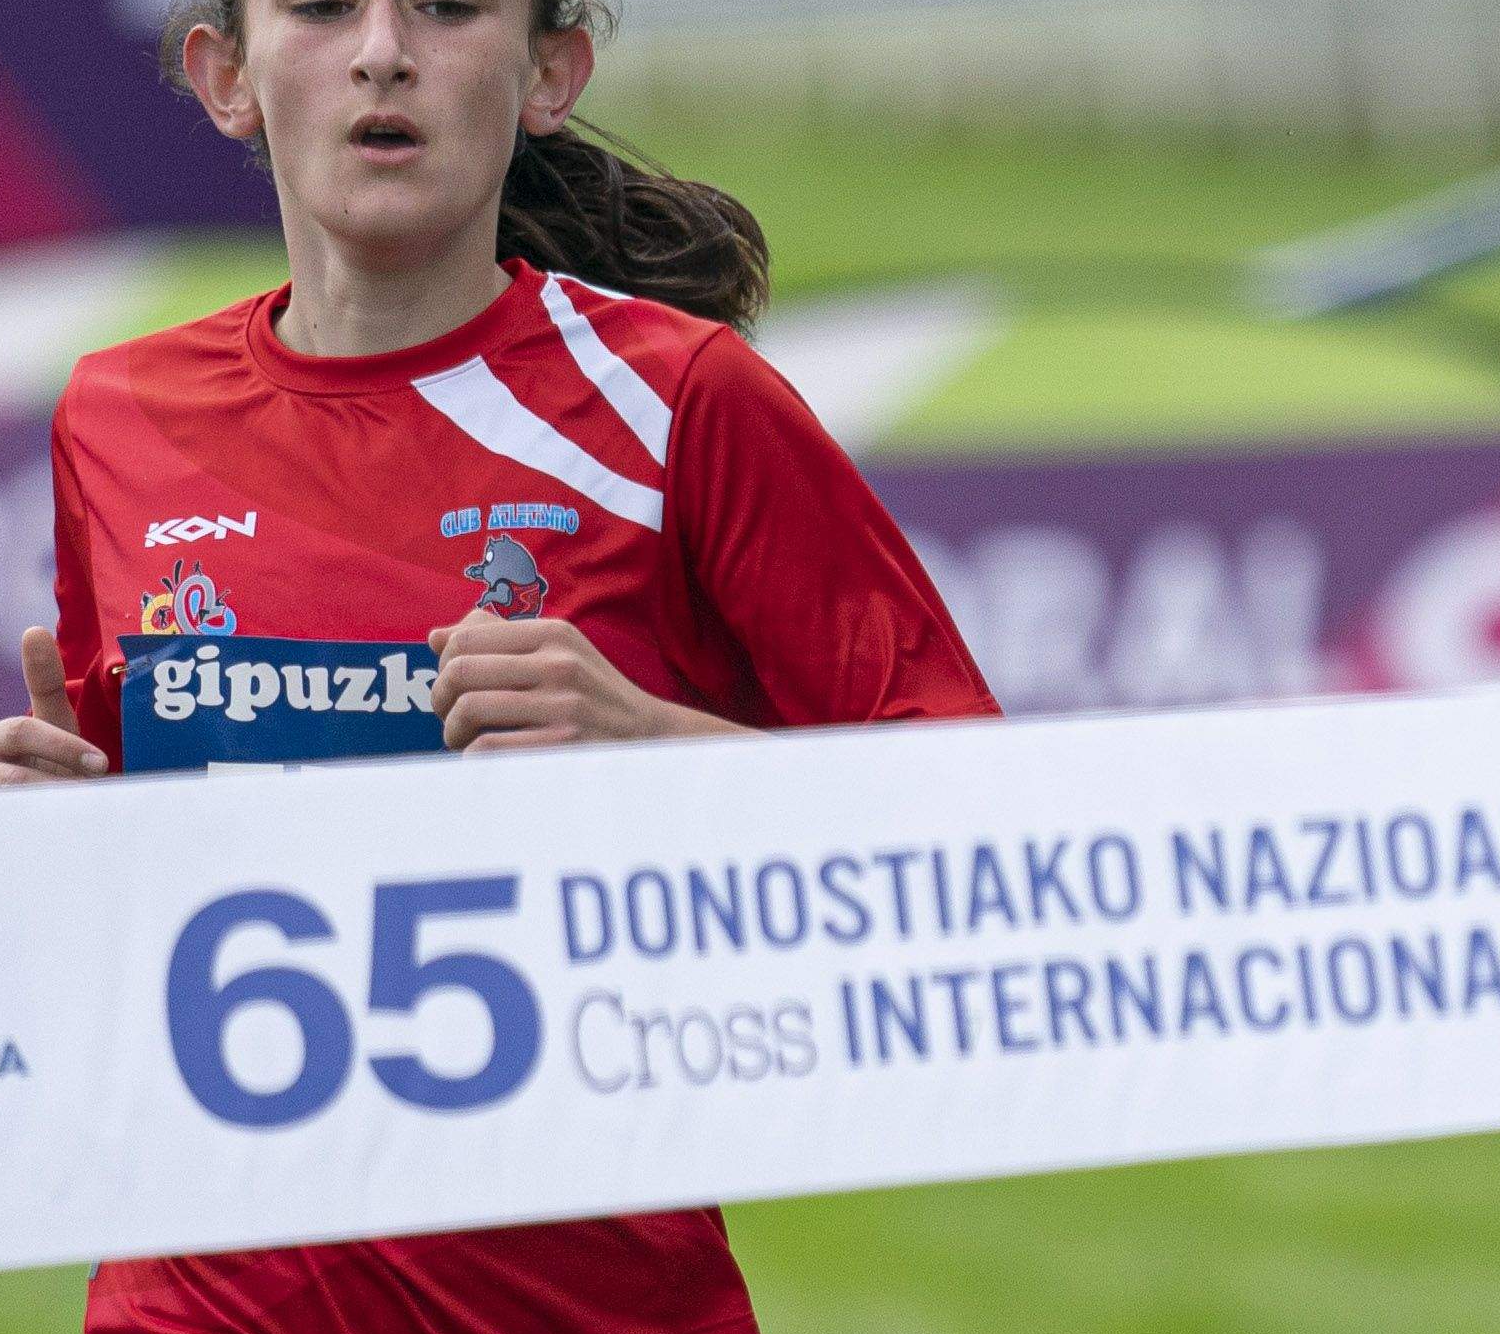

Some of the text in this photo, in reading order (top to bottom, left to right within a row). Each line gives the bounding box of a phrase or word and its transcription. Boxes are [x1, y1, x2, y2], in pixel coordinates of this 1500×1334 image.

[440, 502, 580, 538] CLUB ATLETISMO
[153, 644, 435, 722] gipuzk
[559, 830, 1142, 966] DONOSTIAKO
[164, 874, 545, 1132] 65
[567, 987, 820, 1094] Cross
